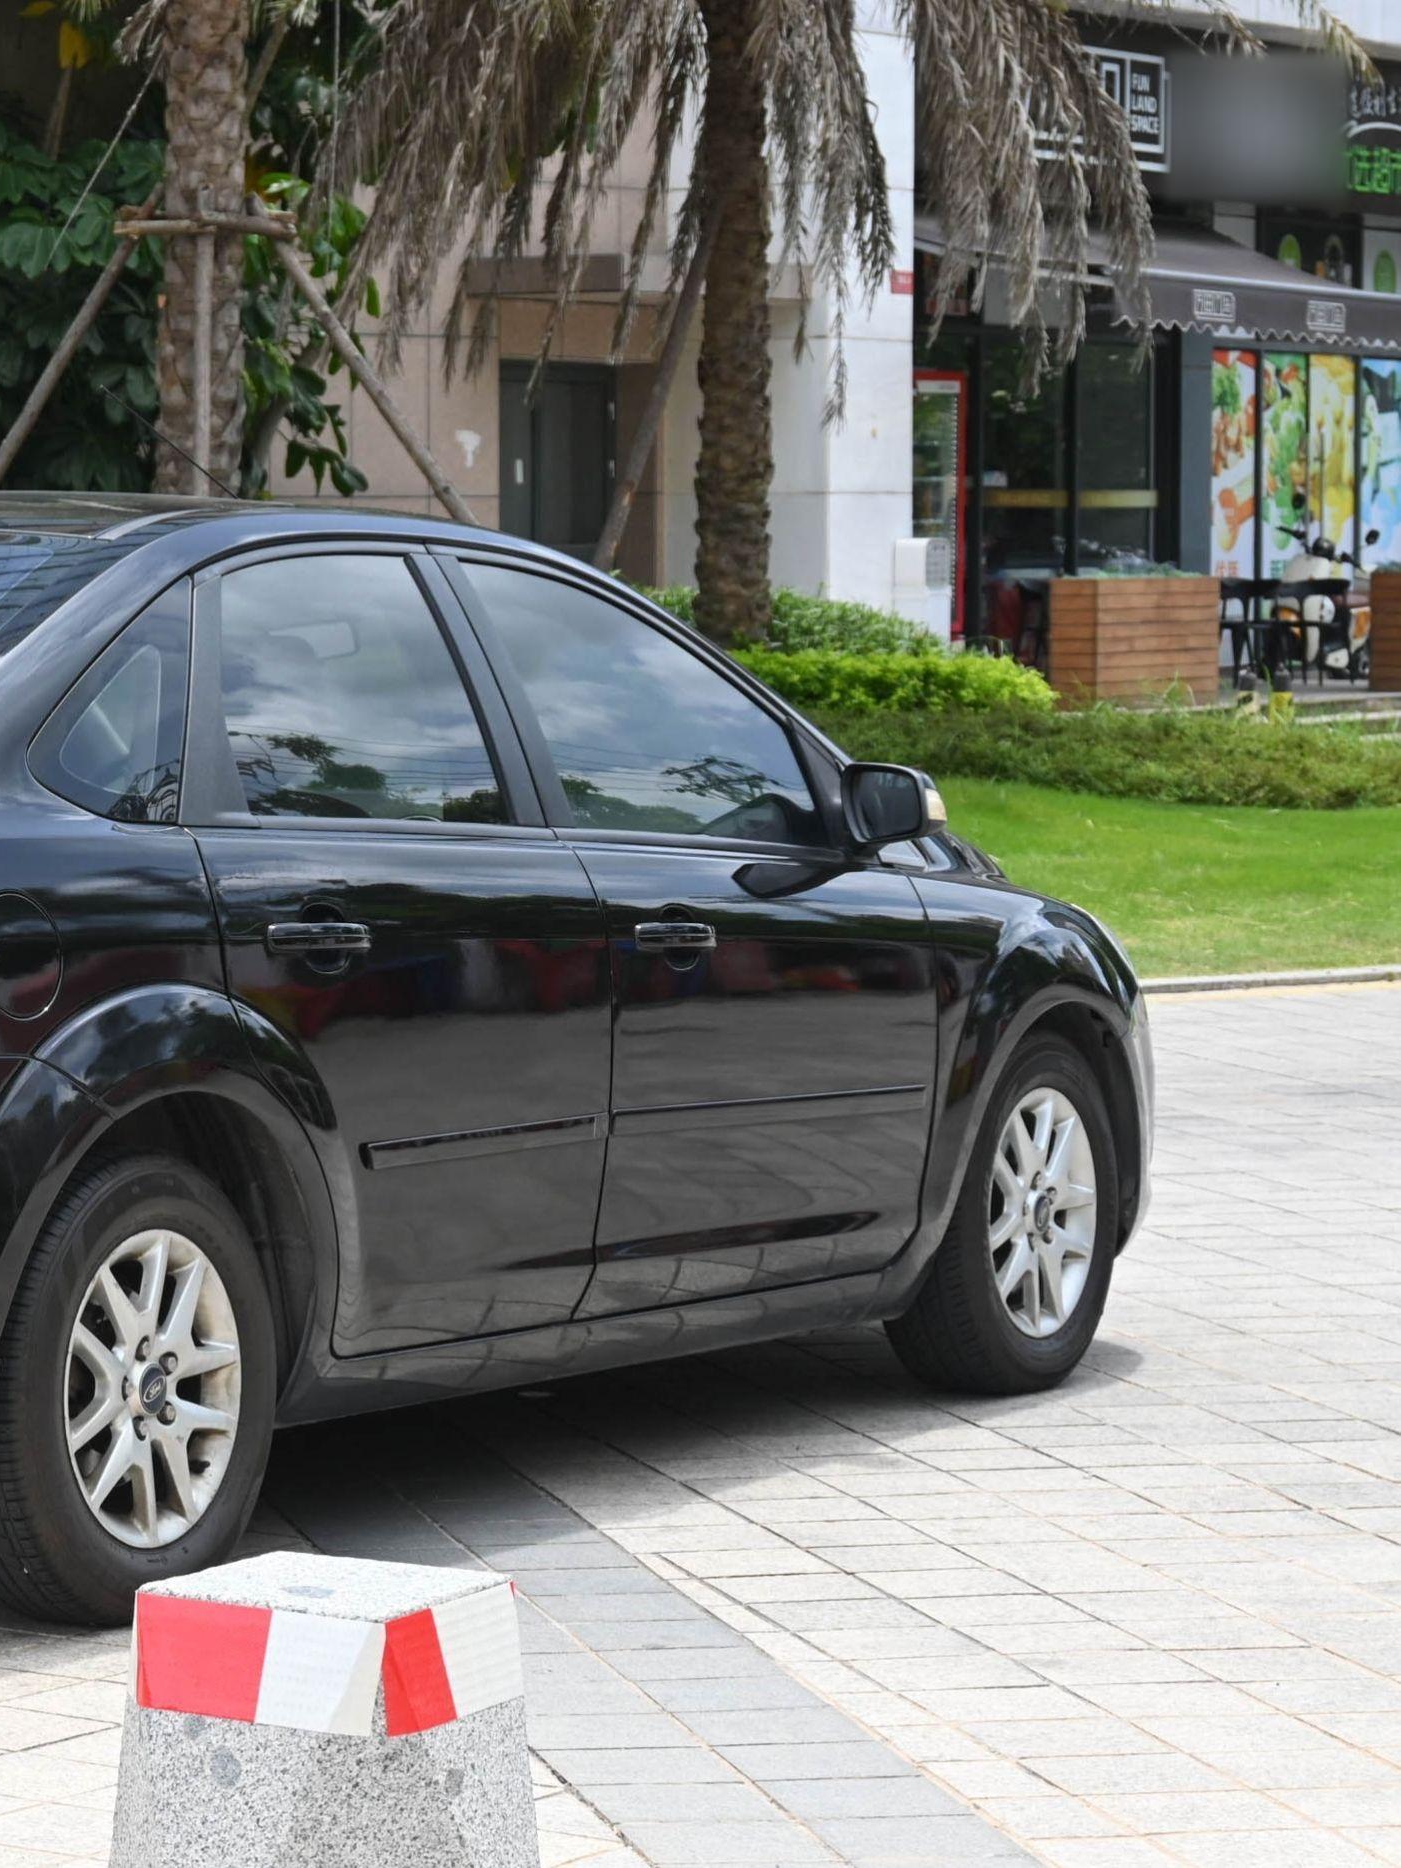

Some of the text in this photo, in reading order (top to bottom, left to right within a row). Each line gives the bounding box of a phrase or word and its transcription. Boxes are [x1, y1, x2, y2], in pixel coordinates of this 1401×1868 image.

[1132, 72, 1150, 91] FUN
[1131, 94, 1157, 113] LAND
[1130, 115, 1159, 134] SPACE
